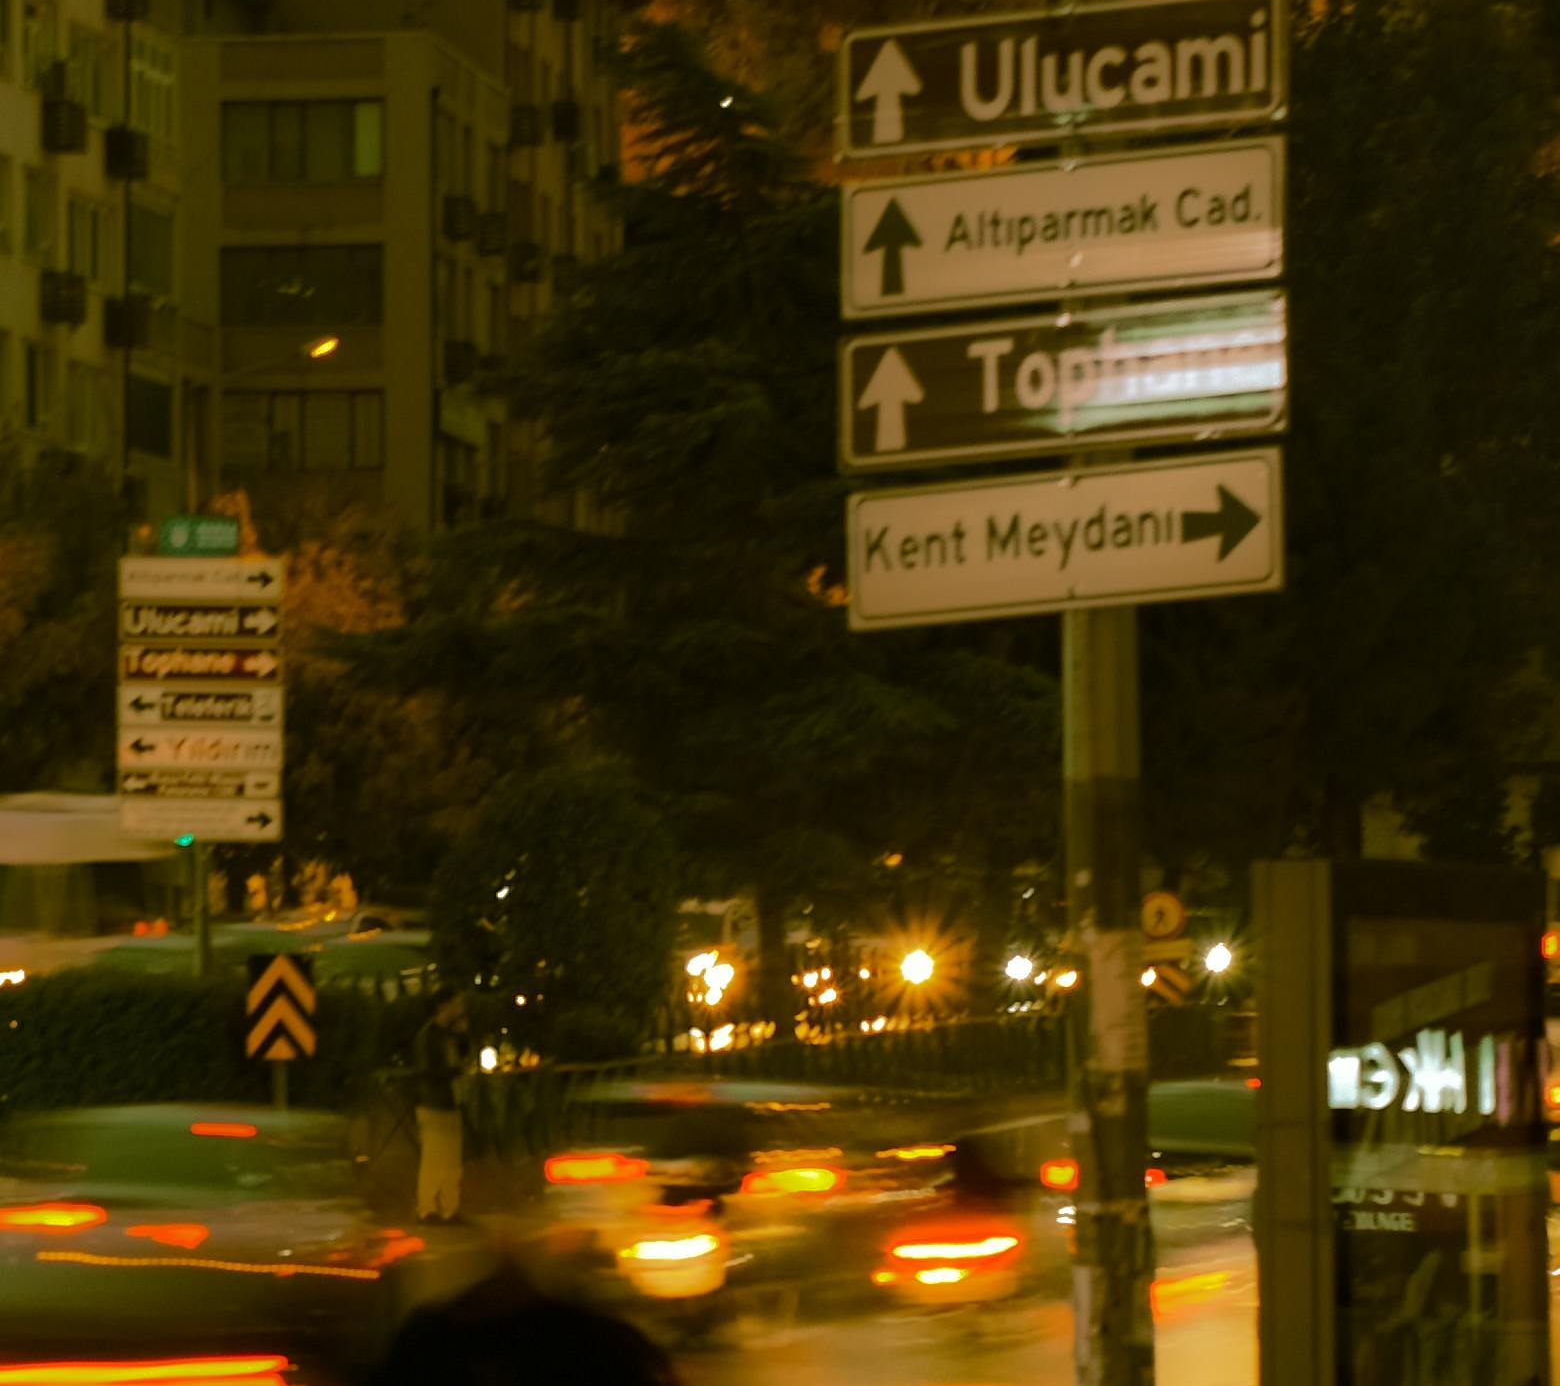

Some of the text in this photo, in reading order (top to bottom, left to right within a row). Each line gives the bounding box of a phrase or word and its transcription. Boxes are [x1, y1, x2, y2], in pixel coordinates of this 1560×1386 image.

[960, 9, 1268, 122] Ulucami
[944, 183, 1263, 260] Altıparmak Cad.
[862, 500, 1176, 574] Kent Meydanı
